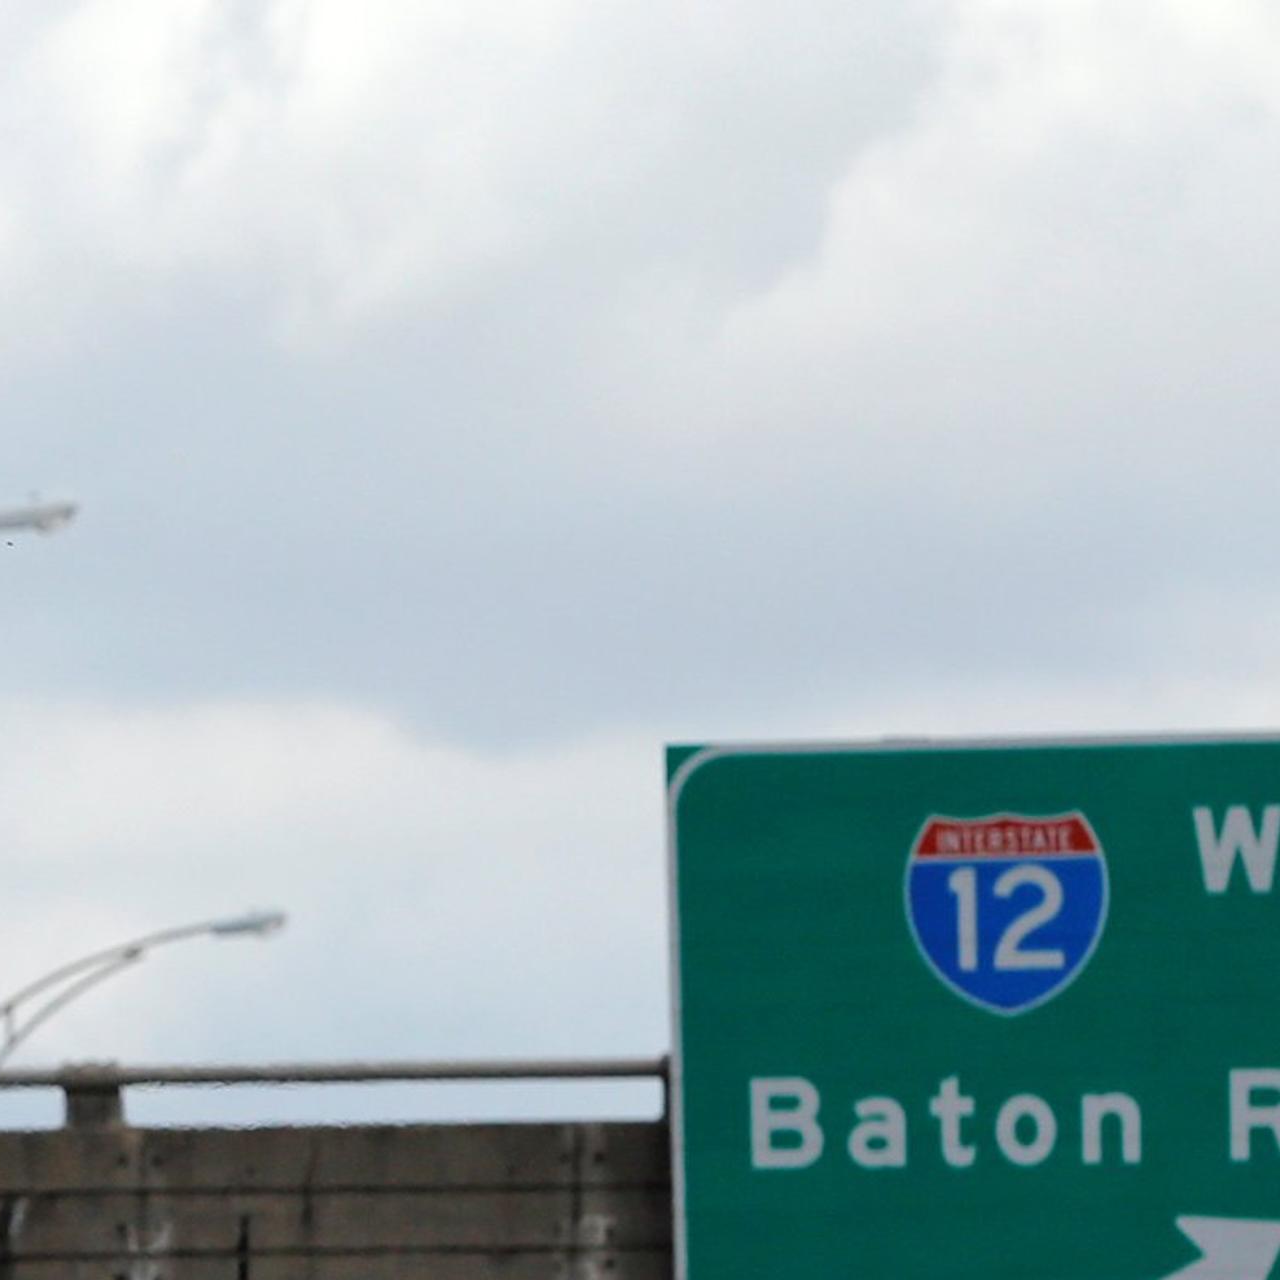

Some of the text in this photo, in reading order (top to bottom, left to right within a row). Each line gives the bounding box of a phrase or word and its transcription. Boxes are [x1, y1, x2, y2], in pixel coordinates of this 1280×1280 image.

[936, 826, 1073, 855] INTERSTATE
[948, 863, 1065, 972] 12
[749, 1075, 1142, 1169] Baton
